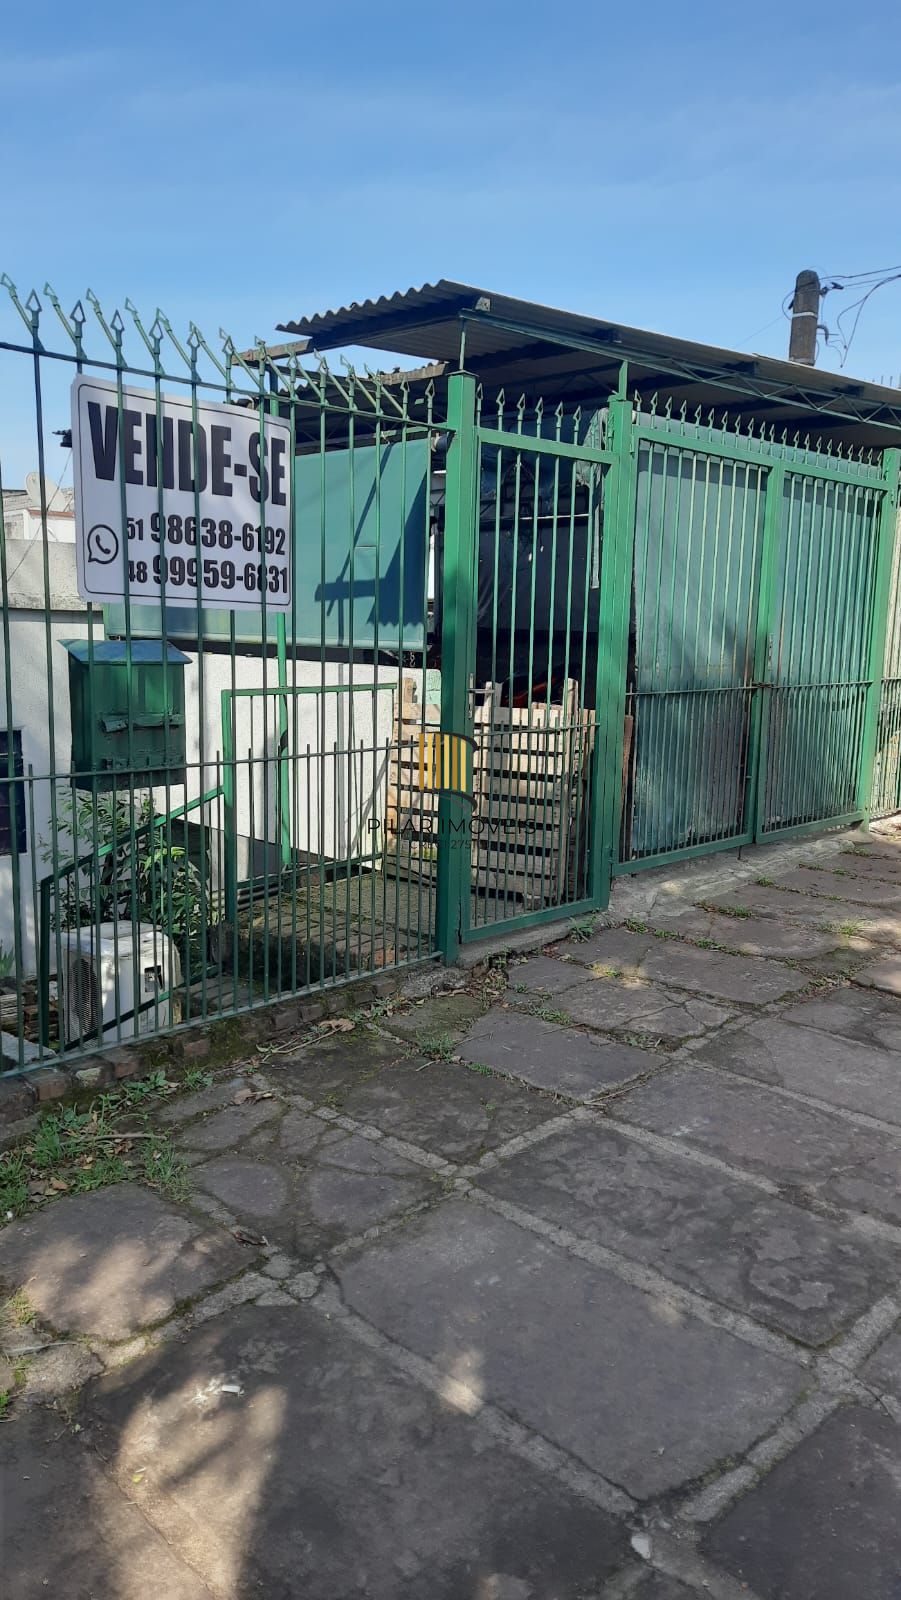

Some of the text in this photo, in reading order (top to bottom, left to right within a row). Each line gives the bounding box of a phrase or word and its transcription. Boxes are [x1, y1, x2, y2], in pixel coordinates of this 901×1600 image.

[88, 402, 286, 506] VENDE-SE
[126, 513, 286, 555] 51 98638-6192
[127, 555, 288, 593] 48 99959-6831
